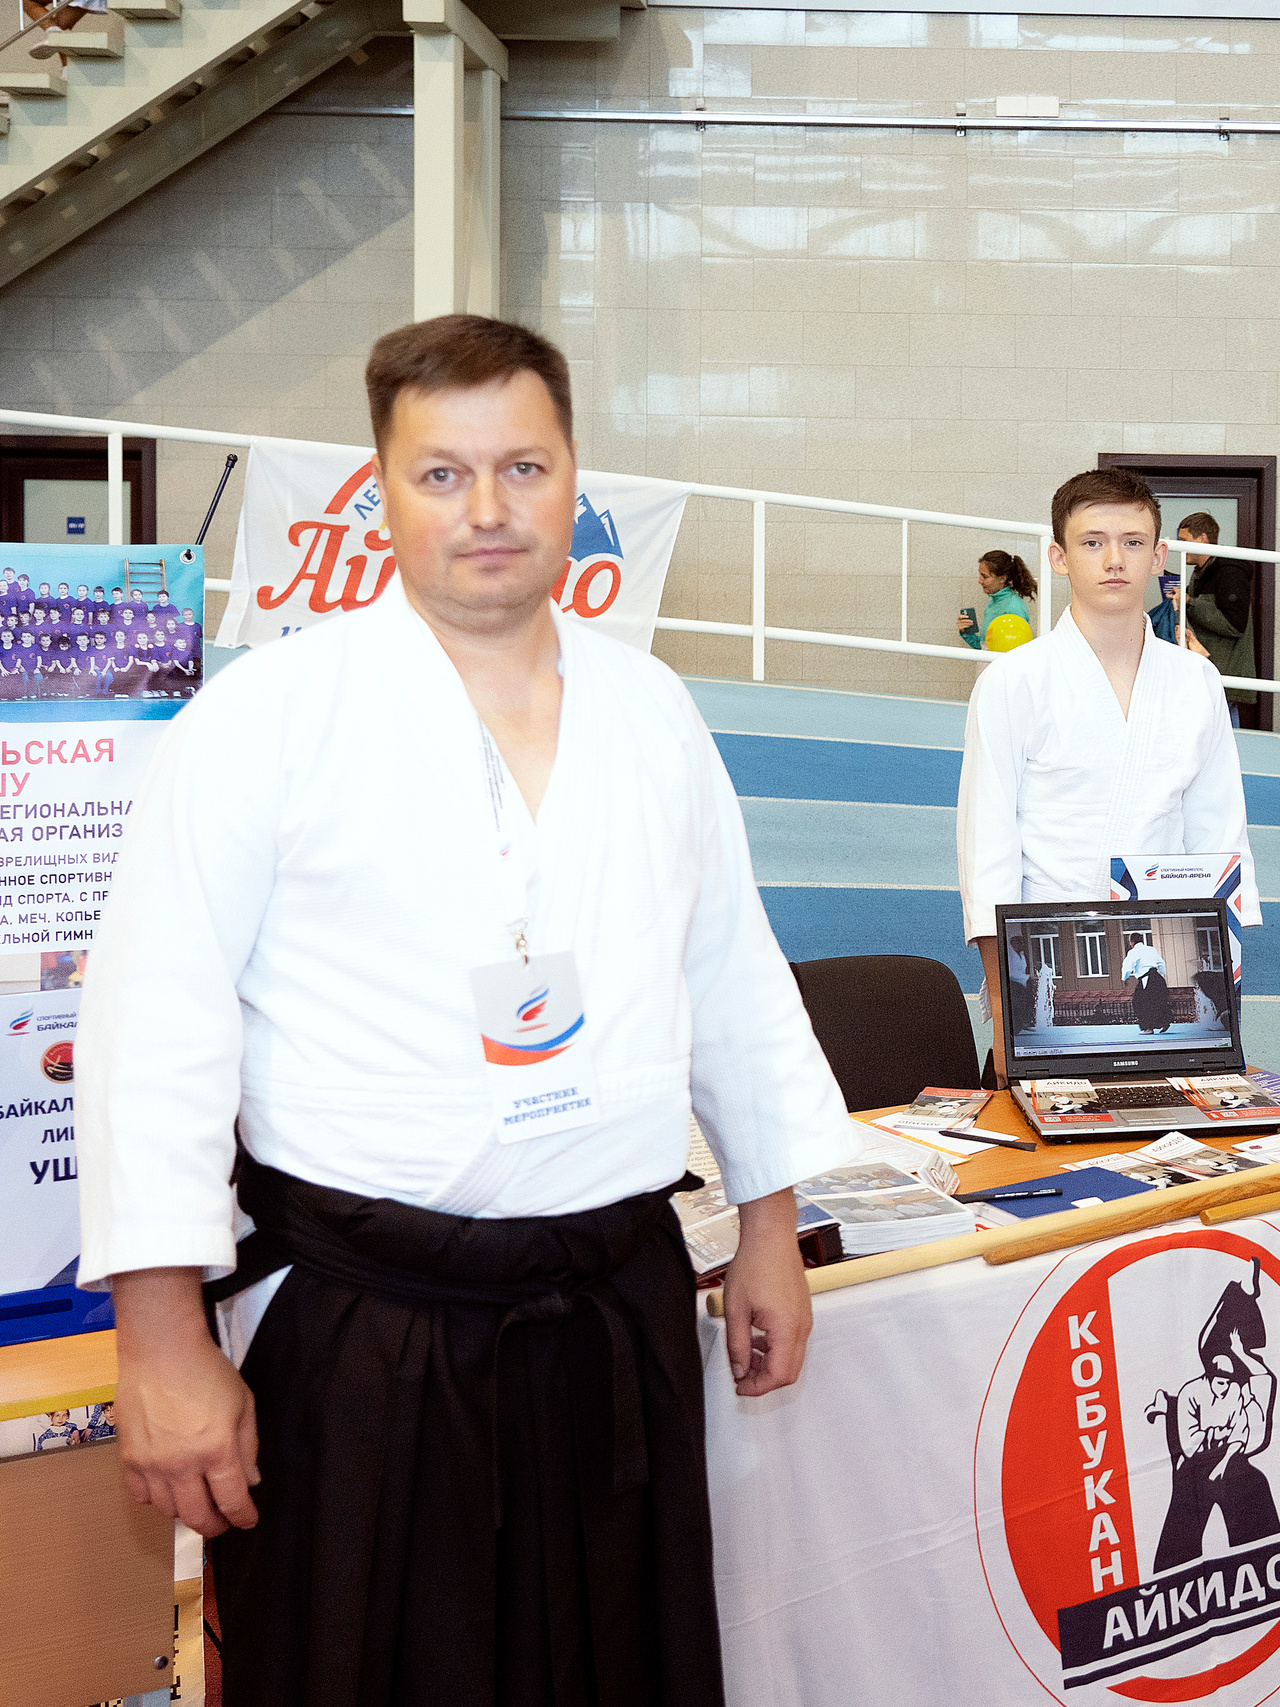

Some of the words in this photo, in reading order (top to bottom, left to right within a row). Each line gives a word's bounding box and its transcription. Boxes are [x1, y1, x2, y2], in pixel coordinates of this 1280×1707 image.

[1, 738, 114, 765] ЬСКАЯ
[0, 772, 31, 797] У
[32, 823, 123, 841] ОРГАНИЗ
[40, 871, 112, 885] СПОРТИВН
[80, 891, 88, 902] С
[56, 910, 101, 922] КОПЬЕ
[0, 929, 50, 944] ЛЬНОЙ
[55, 930, 93, 941] ГИМН
[36, 1012, 77, 1021] СПОРТИВНЫЙ
[41, 1126, 75, 1144] ЛИ
[1067, 1310, 1124, 1594] КОБУКАН
